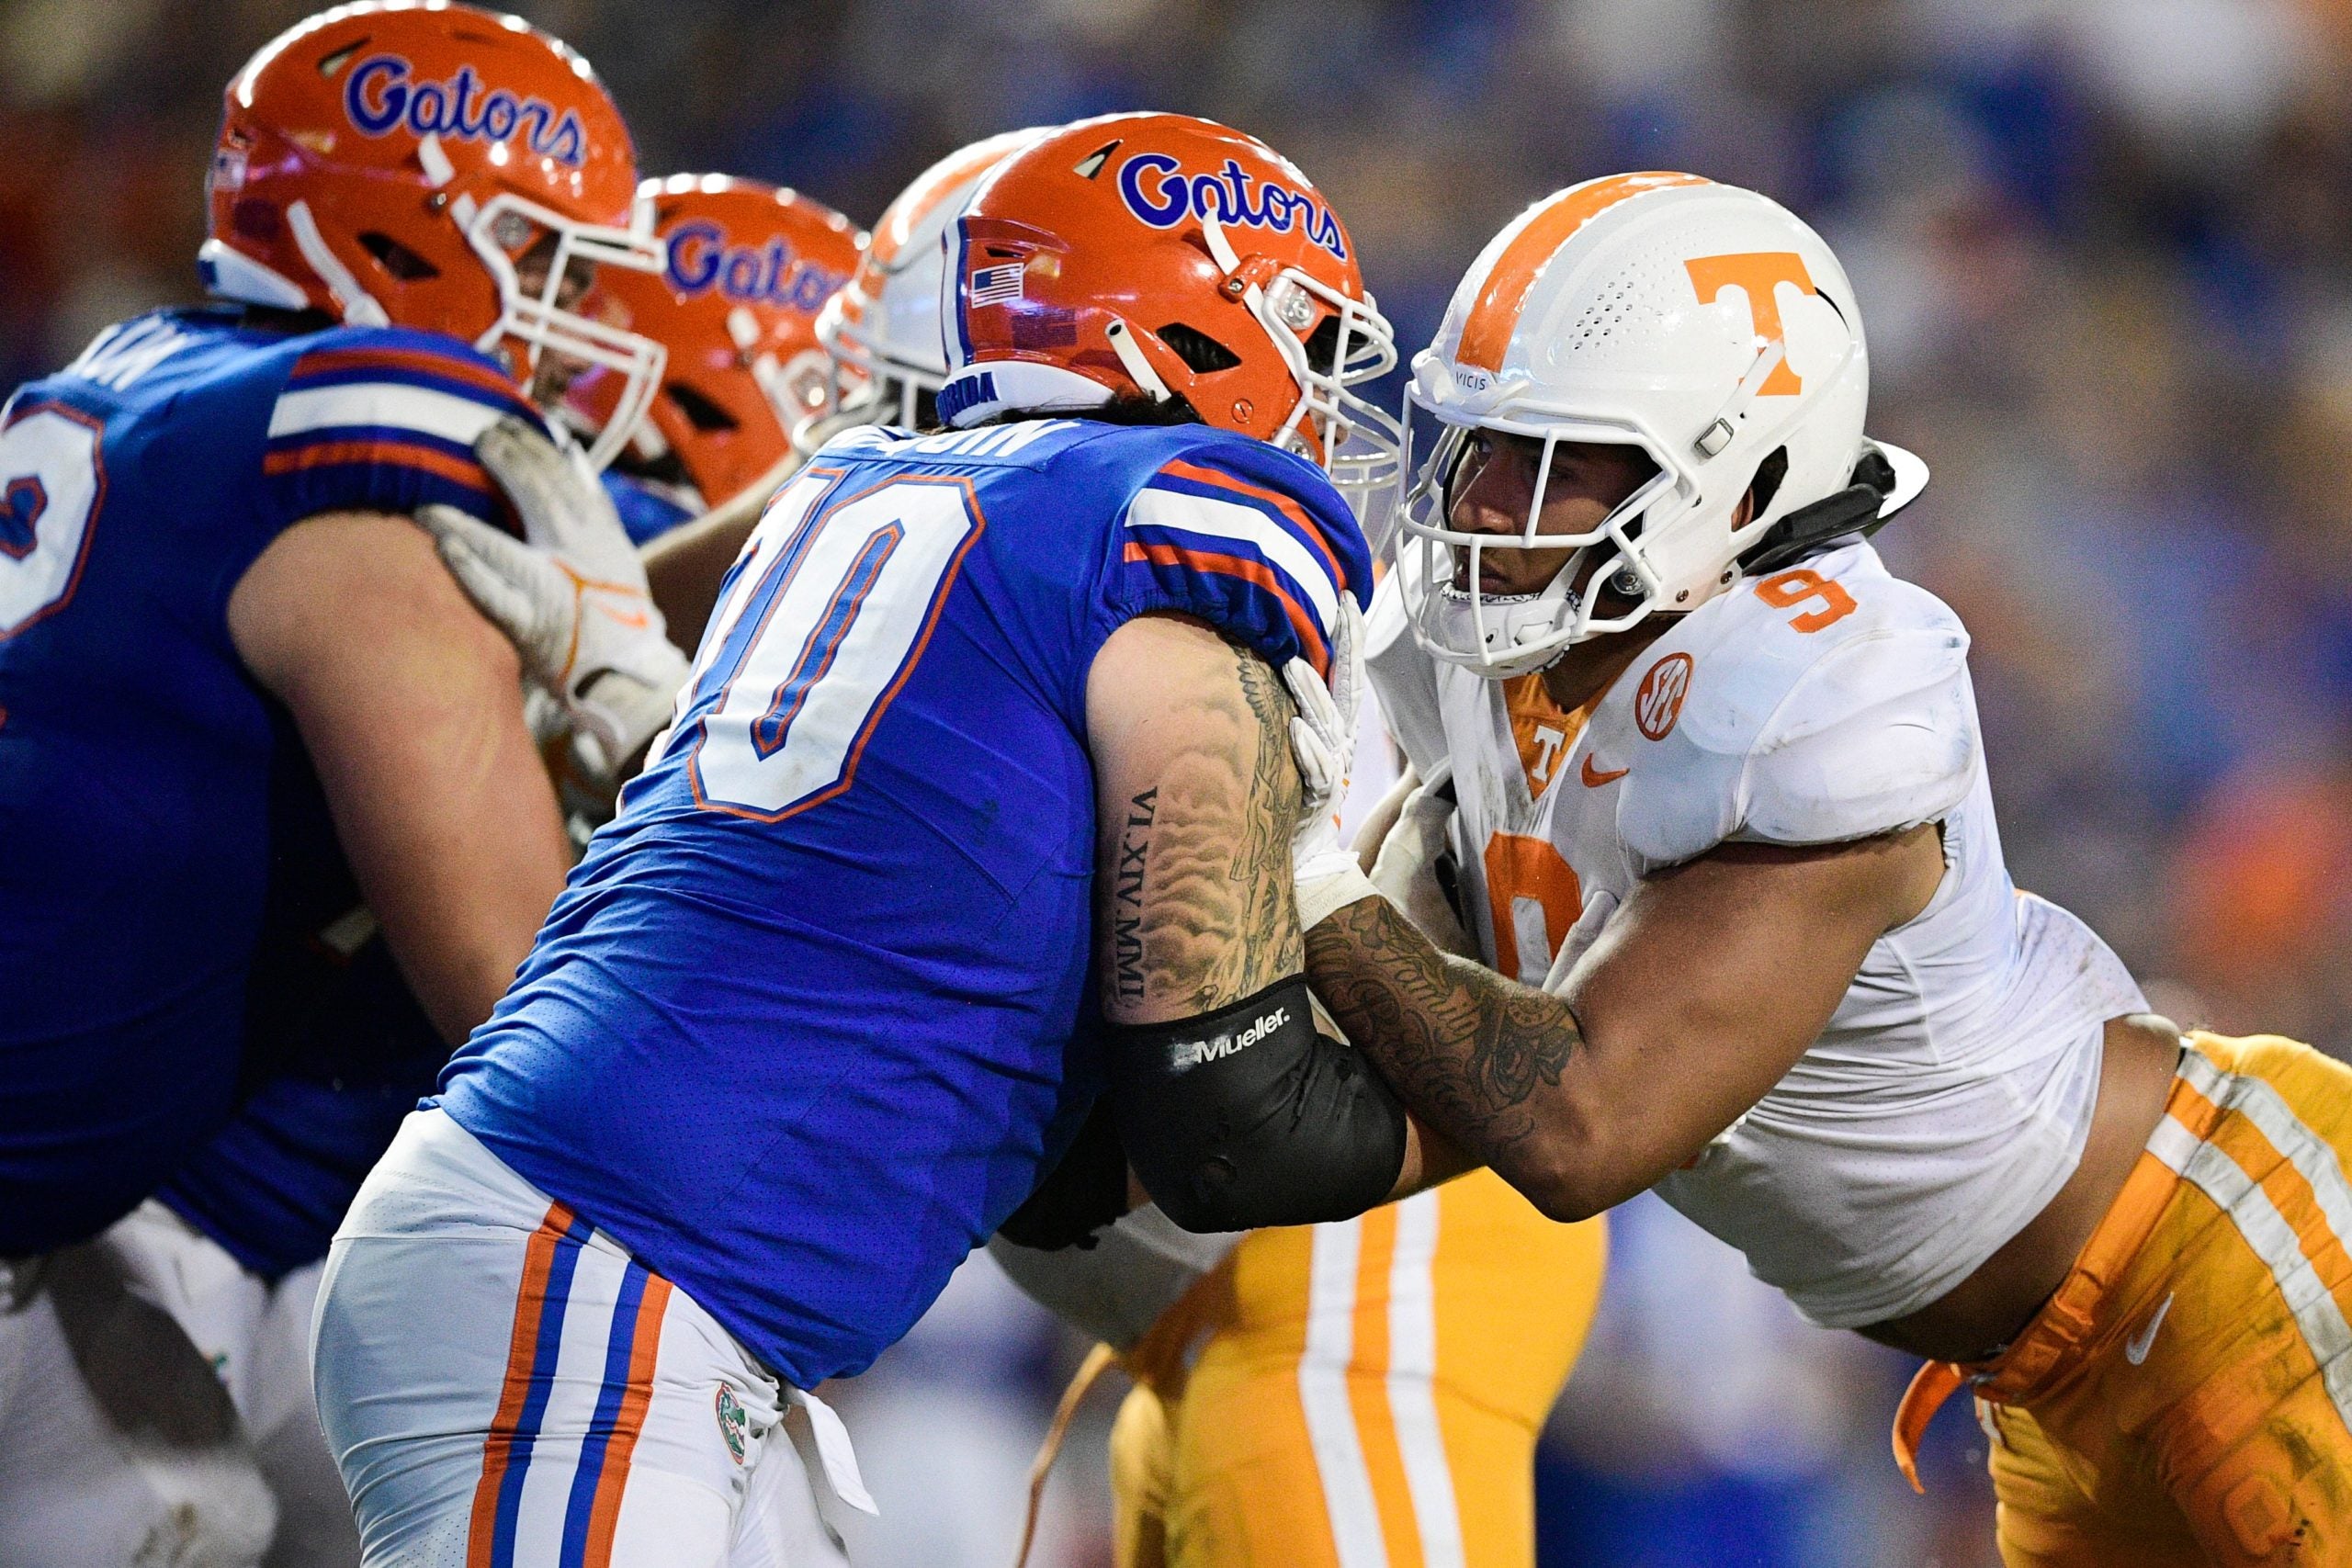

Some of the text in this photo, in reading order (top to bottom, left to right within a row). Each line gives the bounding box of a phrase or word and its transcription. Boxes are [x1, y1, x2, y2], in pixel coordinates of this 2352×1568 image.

[344, 53, 588, 167] Gators
[1117, 152, 1348, 265] Gators
[665, 217, 849, 313] Gato
[1684, 252, 1817, 397] T
[1455, 371, 1487, 390] VICIS
[643, 468, 987, 823] 70
[1753, 569, 1858, 634] 9
[1636, 653, 1691, 739] SEC
[1532, 724, 1565, 782] T
